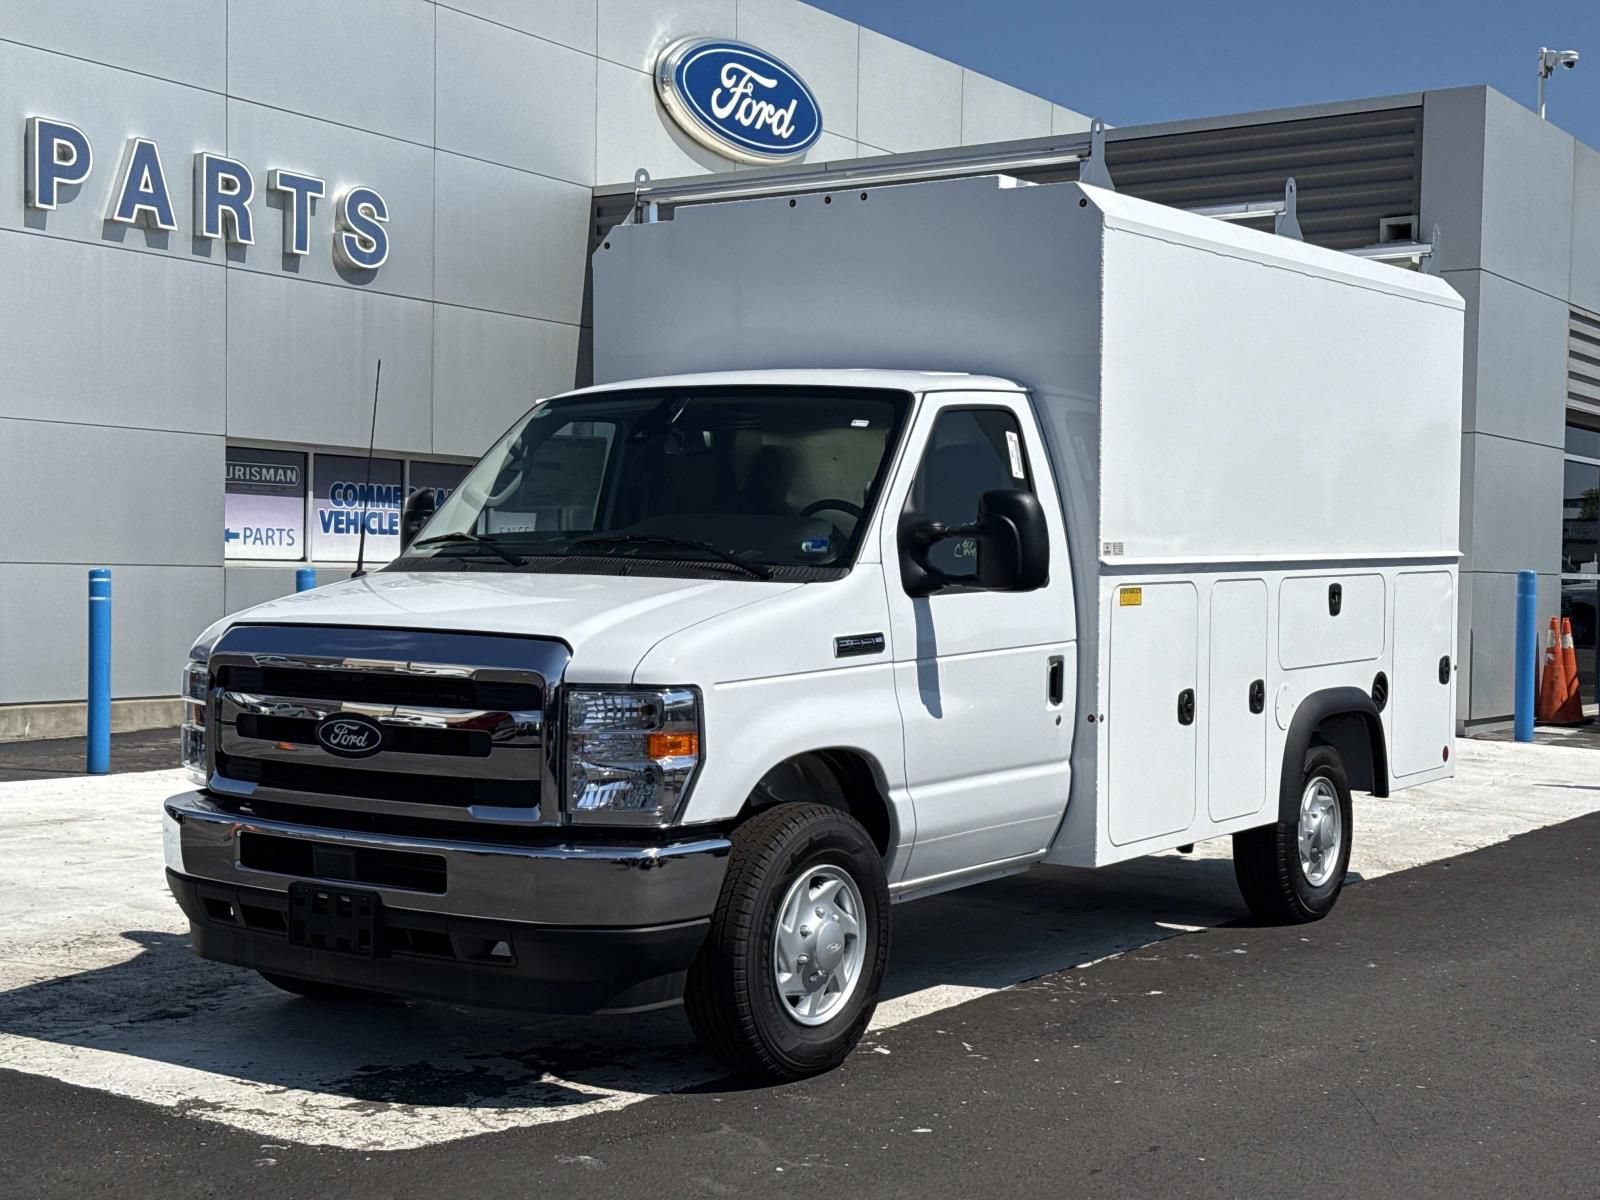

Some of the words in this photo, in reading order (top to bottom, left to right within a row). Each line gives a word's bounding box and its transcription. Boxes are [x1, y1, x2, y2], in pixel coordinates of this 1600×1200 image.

[711, 62, 798, 139] Ford
[26, 116, 390, 269] PARTS
[243, 526, 295, 547] PARTS
[330, 723, 369, 747] Ford
